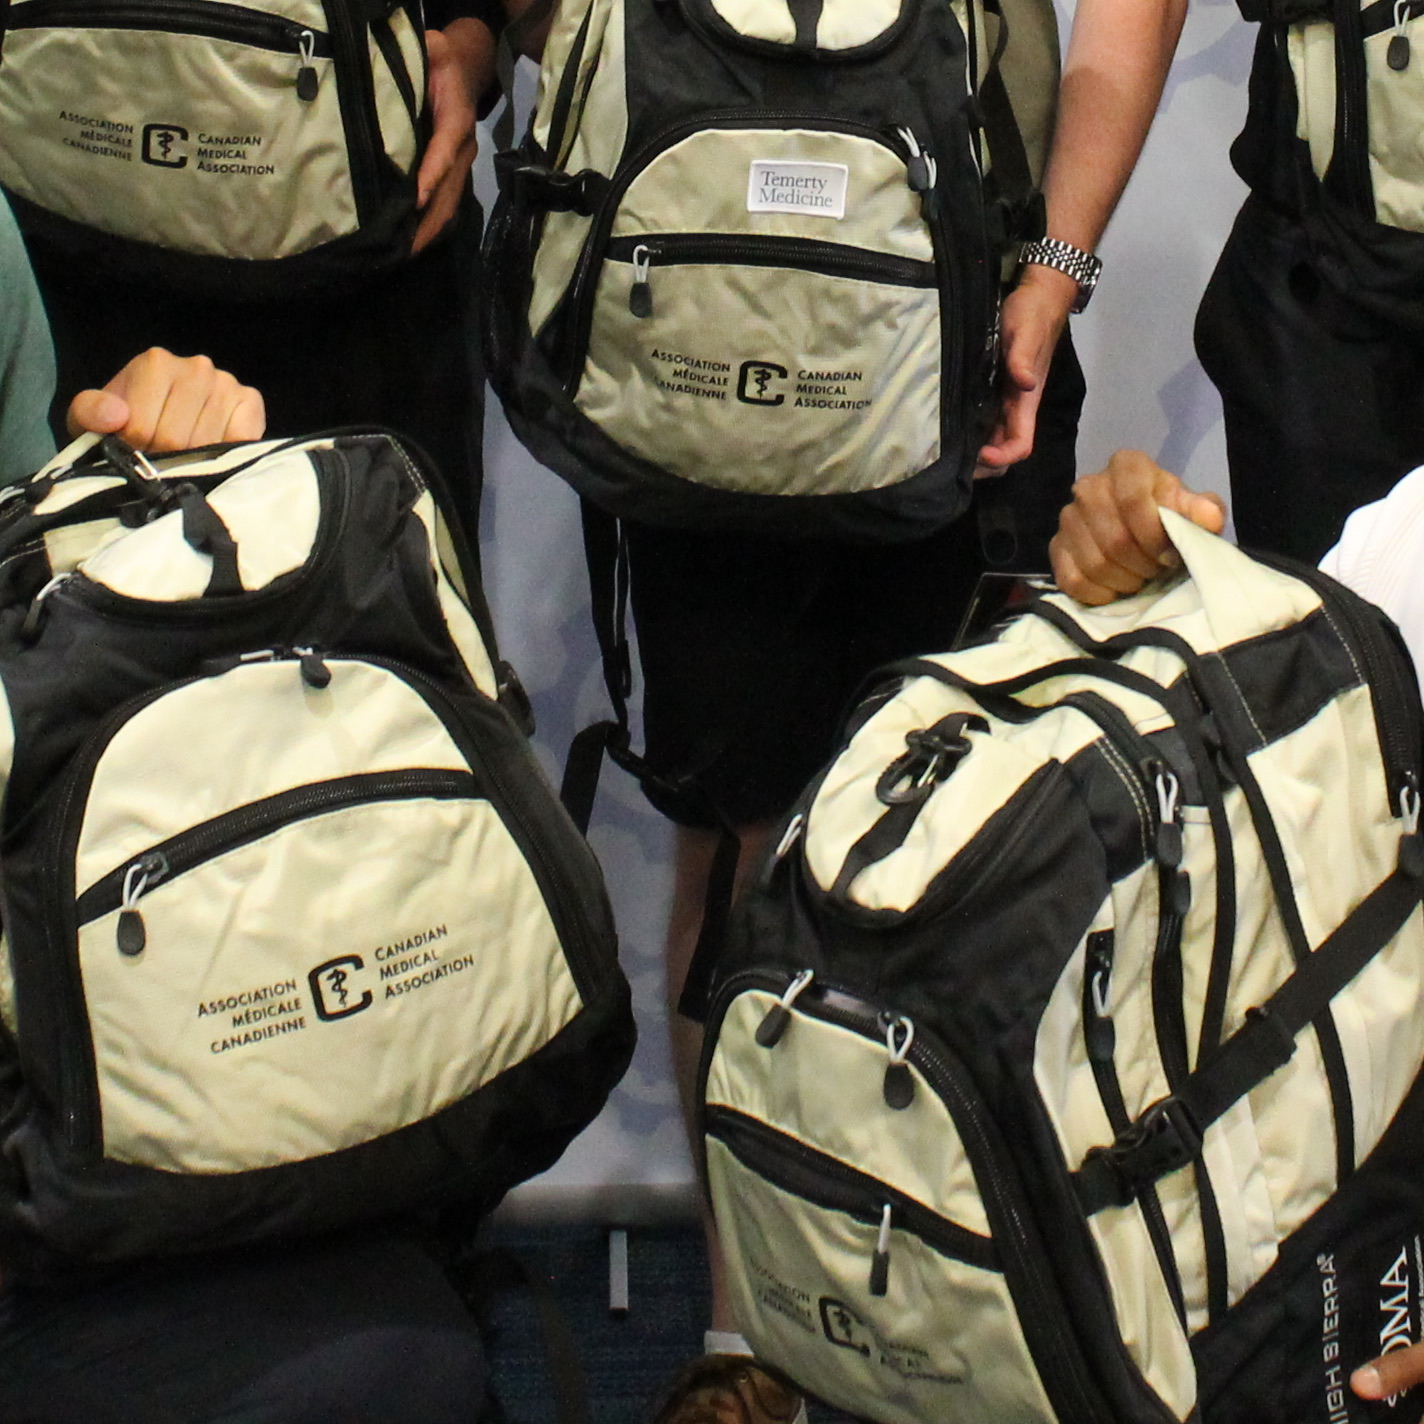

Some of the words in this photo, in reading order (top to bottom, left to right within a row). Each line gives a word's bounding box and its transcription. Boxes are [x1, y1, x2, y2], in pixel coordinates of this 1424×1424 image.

[59, 110, 134, 133] ASSOCIATION
[197, 133, 261, 147] CANADIAN
[197, 148, 248, 160] MEDICAL
[197, 161, 275, 175] ASSOCIATION
[761, 170, 827, 194] Temerty
[759, 188, 833, 208] Medicine
[651, 348, 731, 373] ASSOCIATION
[797, 369, 862, 382] CANADIAN
[796, 383, 847, 396] MEDICAL
[794, 396, 872, 411] ASSOCIATION
[375, 923, 448, 962] CANADIAN
[379, 949, 439, 982] MEDICAL
[384, 954, 475, 1000] ASSOCIATION
[197, 978, 298, 1019] ASSOCIATION
[210, 1016, 307, 1055] CANADIENNE
